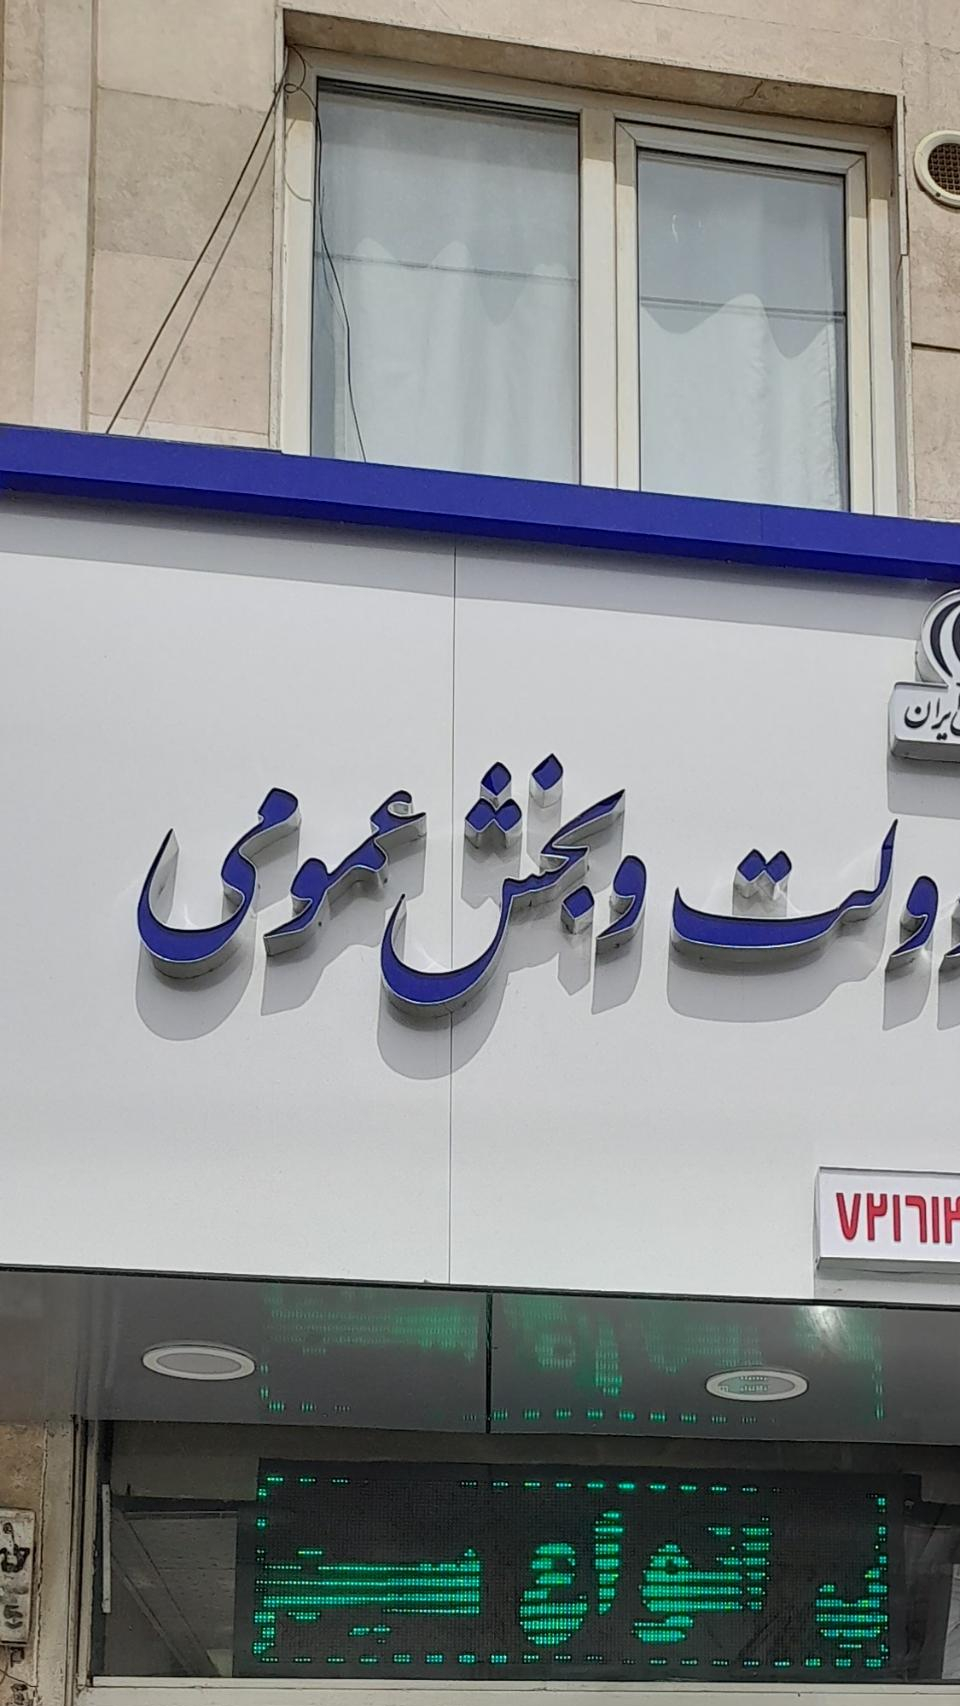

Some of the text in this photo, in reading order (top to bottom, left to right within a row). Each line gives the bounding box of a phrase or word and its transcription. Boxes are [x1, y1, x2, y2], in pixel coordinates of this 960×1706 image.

[138, 786, 426, 964] عمومی
[381, 753, 625, 1008] بخش
[596, 854, 646, 946] و
